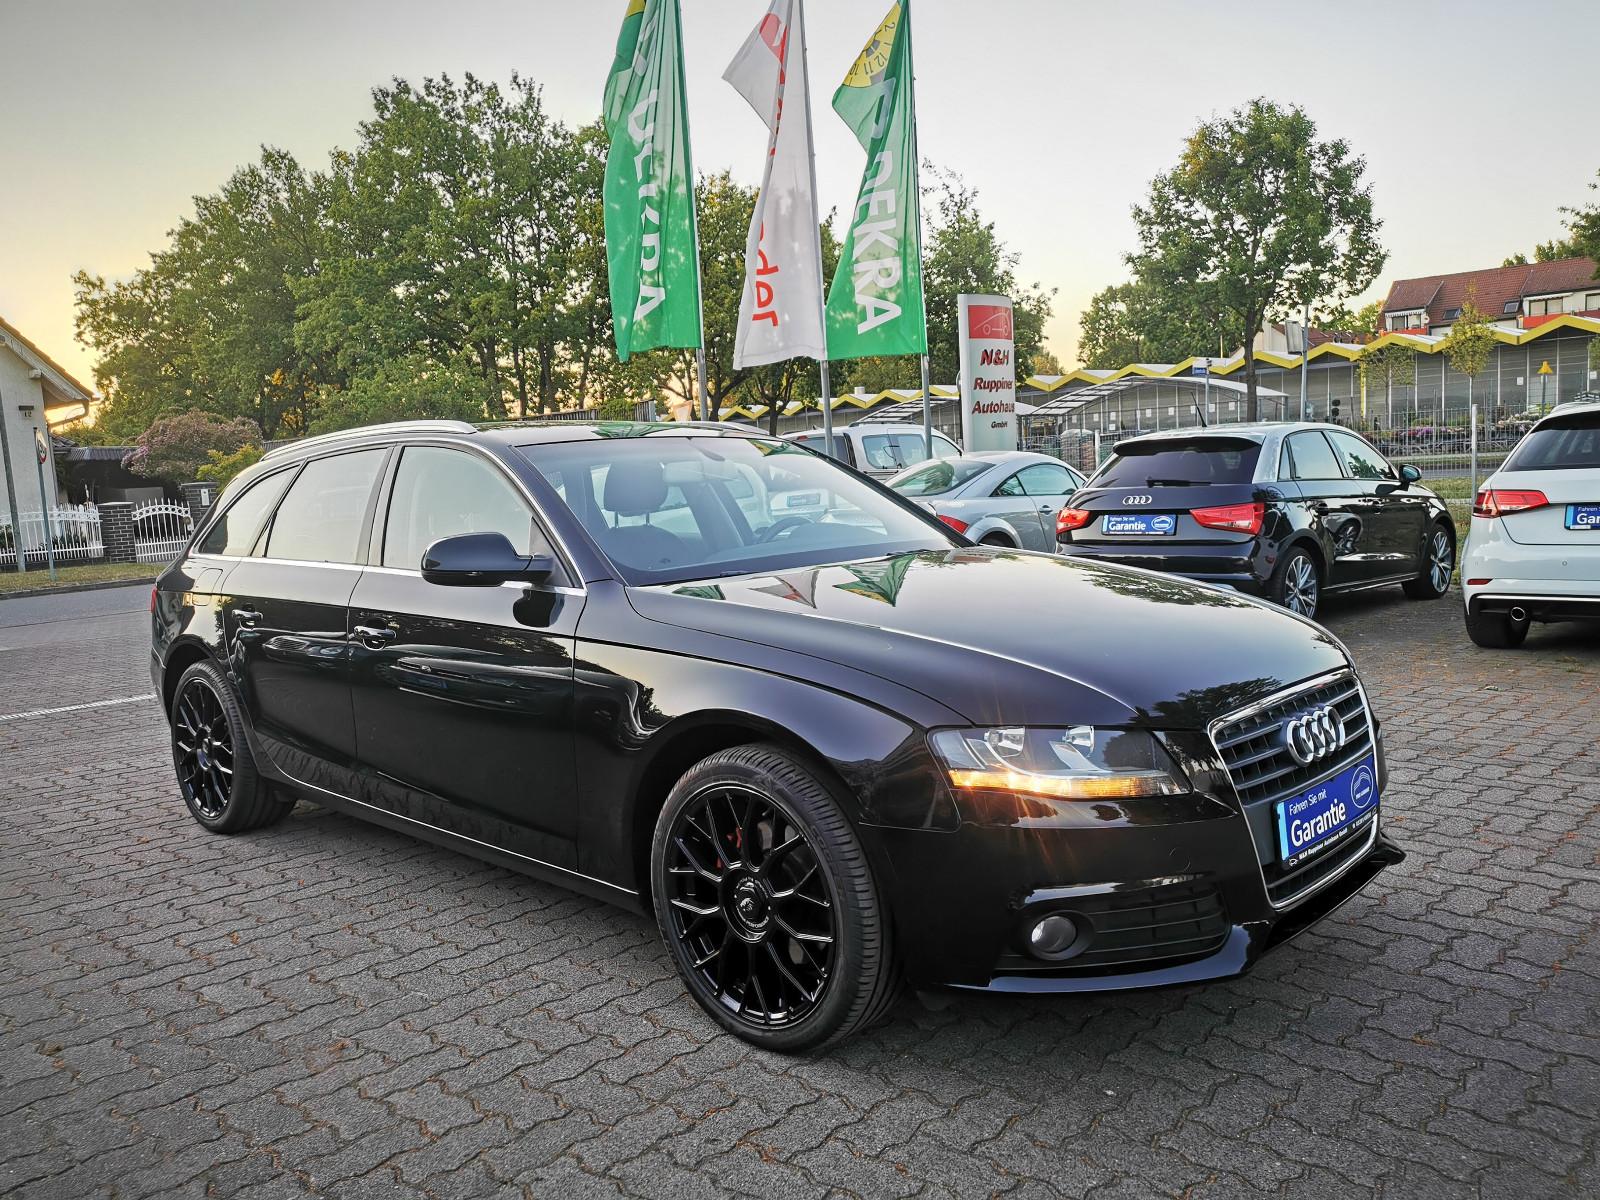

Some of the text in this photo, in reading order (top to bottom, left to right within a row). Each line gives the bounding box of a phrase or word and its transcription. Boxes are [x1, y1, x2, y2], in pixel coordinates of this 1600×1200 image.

[980, 349, 1010, 367] N&H
[973, 377, 1014, 392] Ruppiner
[971, 400, 1015, 415] Autohaus
[1108, 521, 1146, 531] Garantie
[1289, 788, 1327, 816] Fahren Sie mit
[1291, 798, 1346, 847] Garantie
